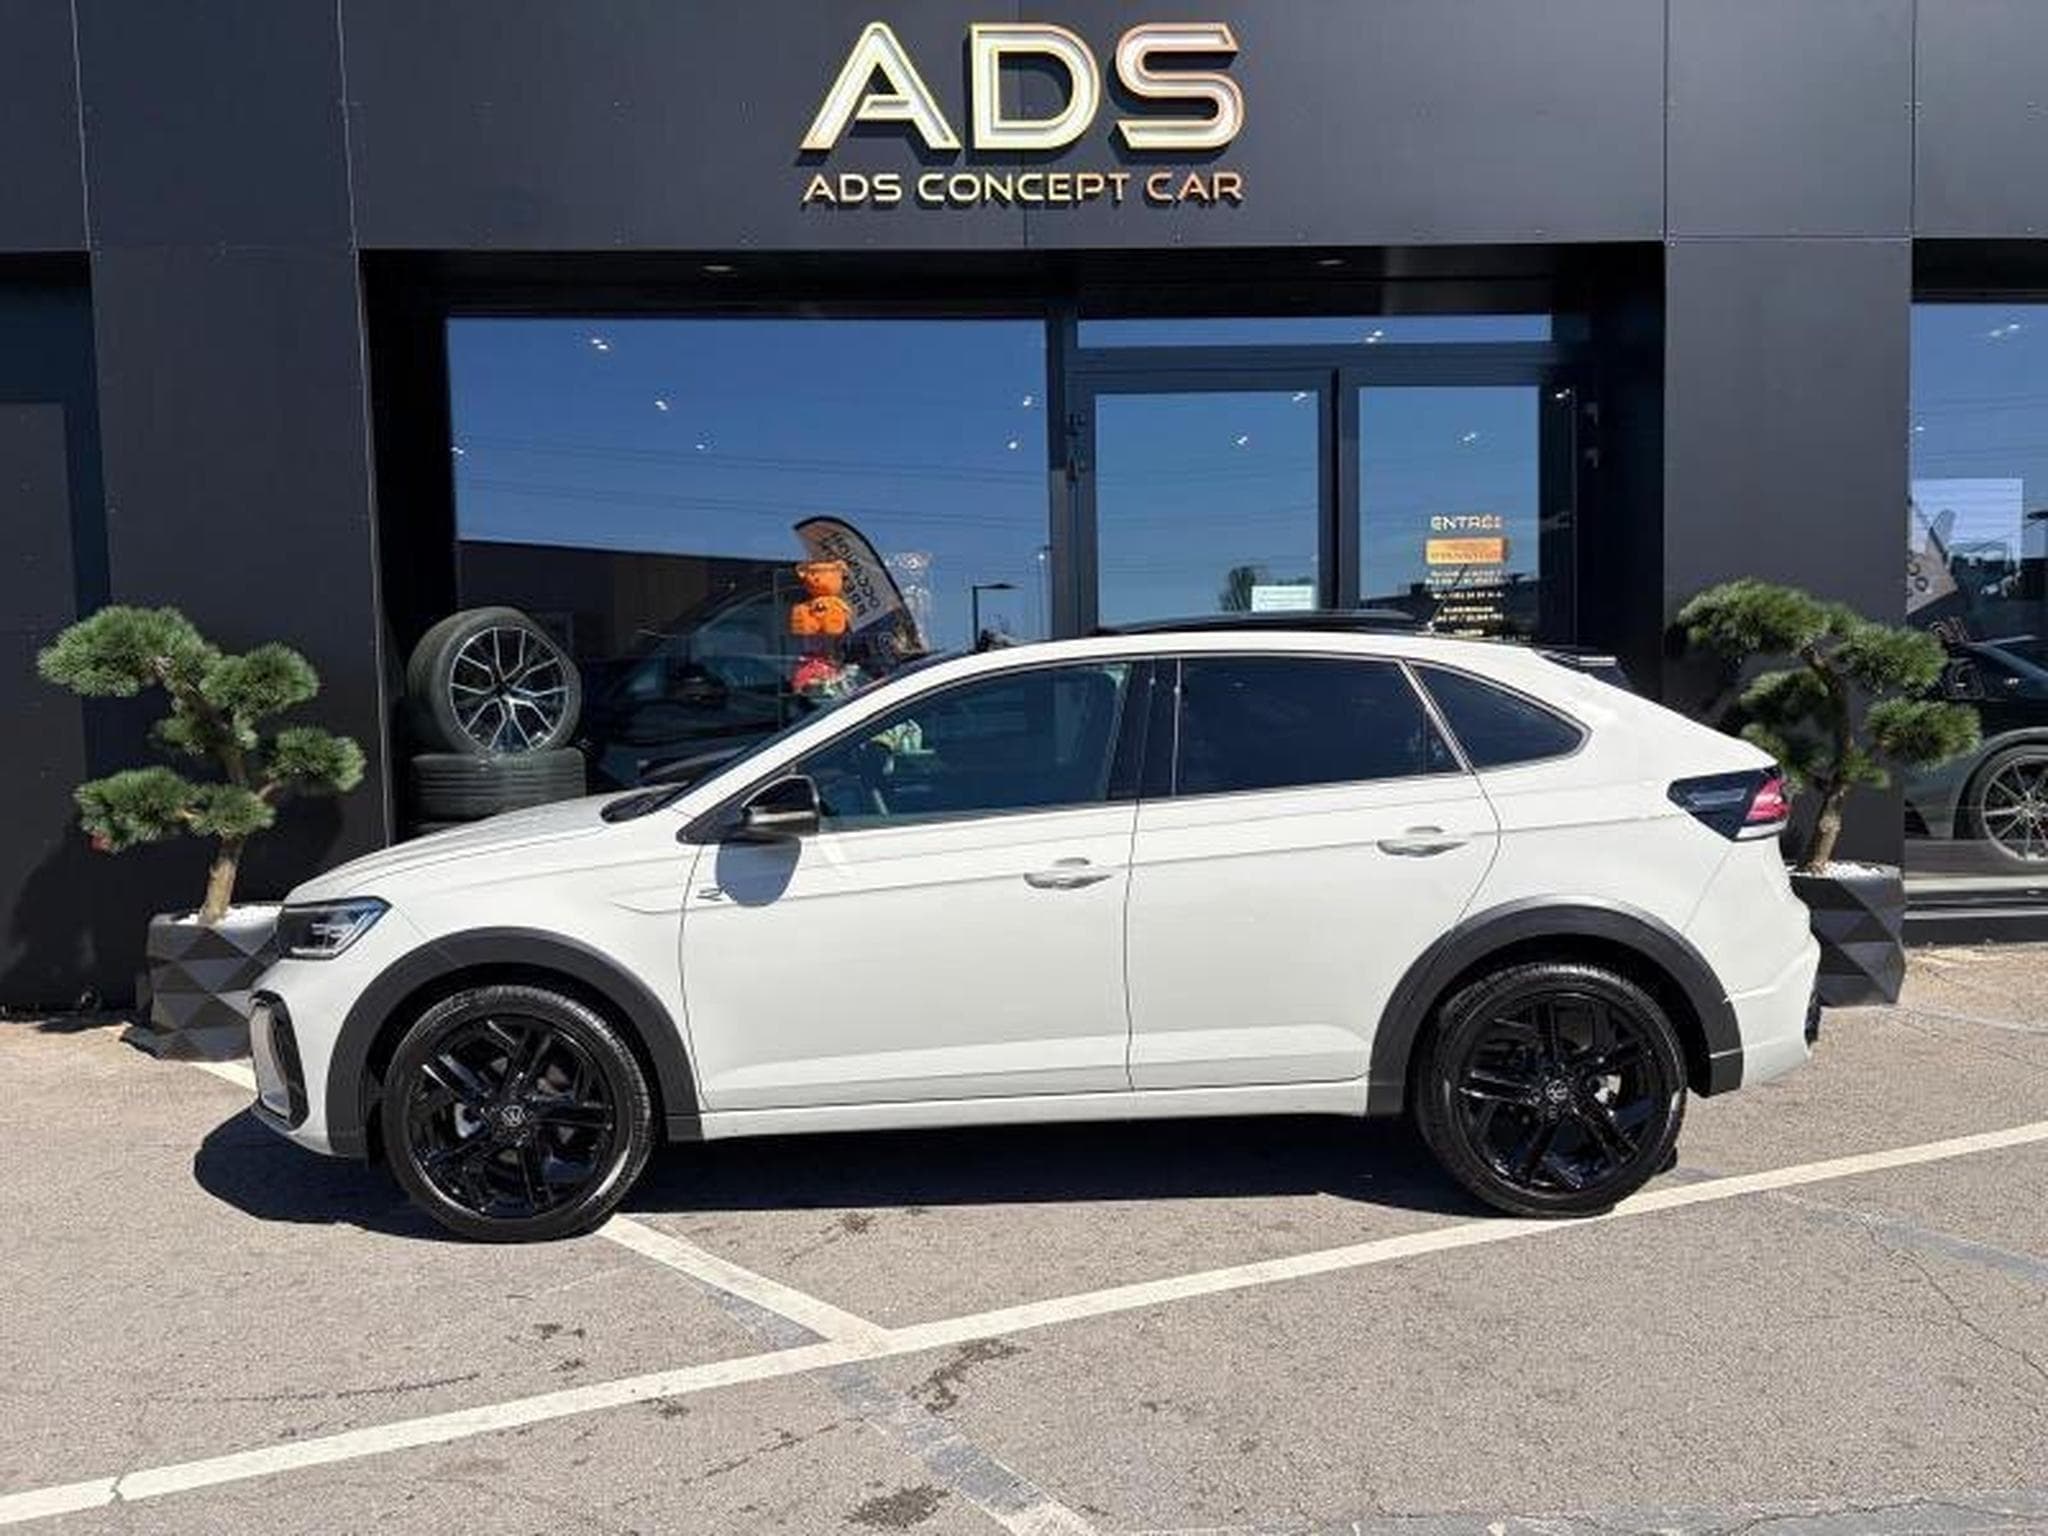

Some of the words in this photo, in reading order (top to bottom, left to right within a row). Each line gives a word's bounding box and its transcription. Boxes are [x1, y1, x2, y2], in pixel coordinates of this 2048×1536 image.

[799, 21, 1244, 151] ADS
[802, 173, 902, 202] ADS
[917, 173, 1131, 202] CONCEPT
[1146, 173, 1244, 202] CAR
